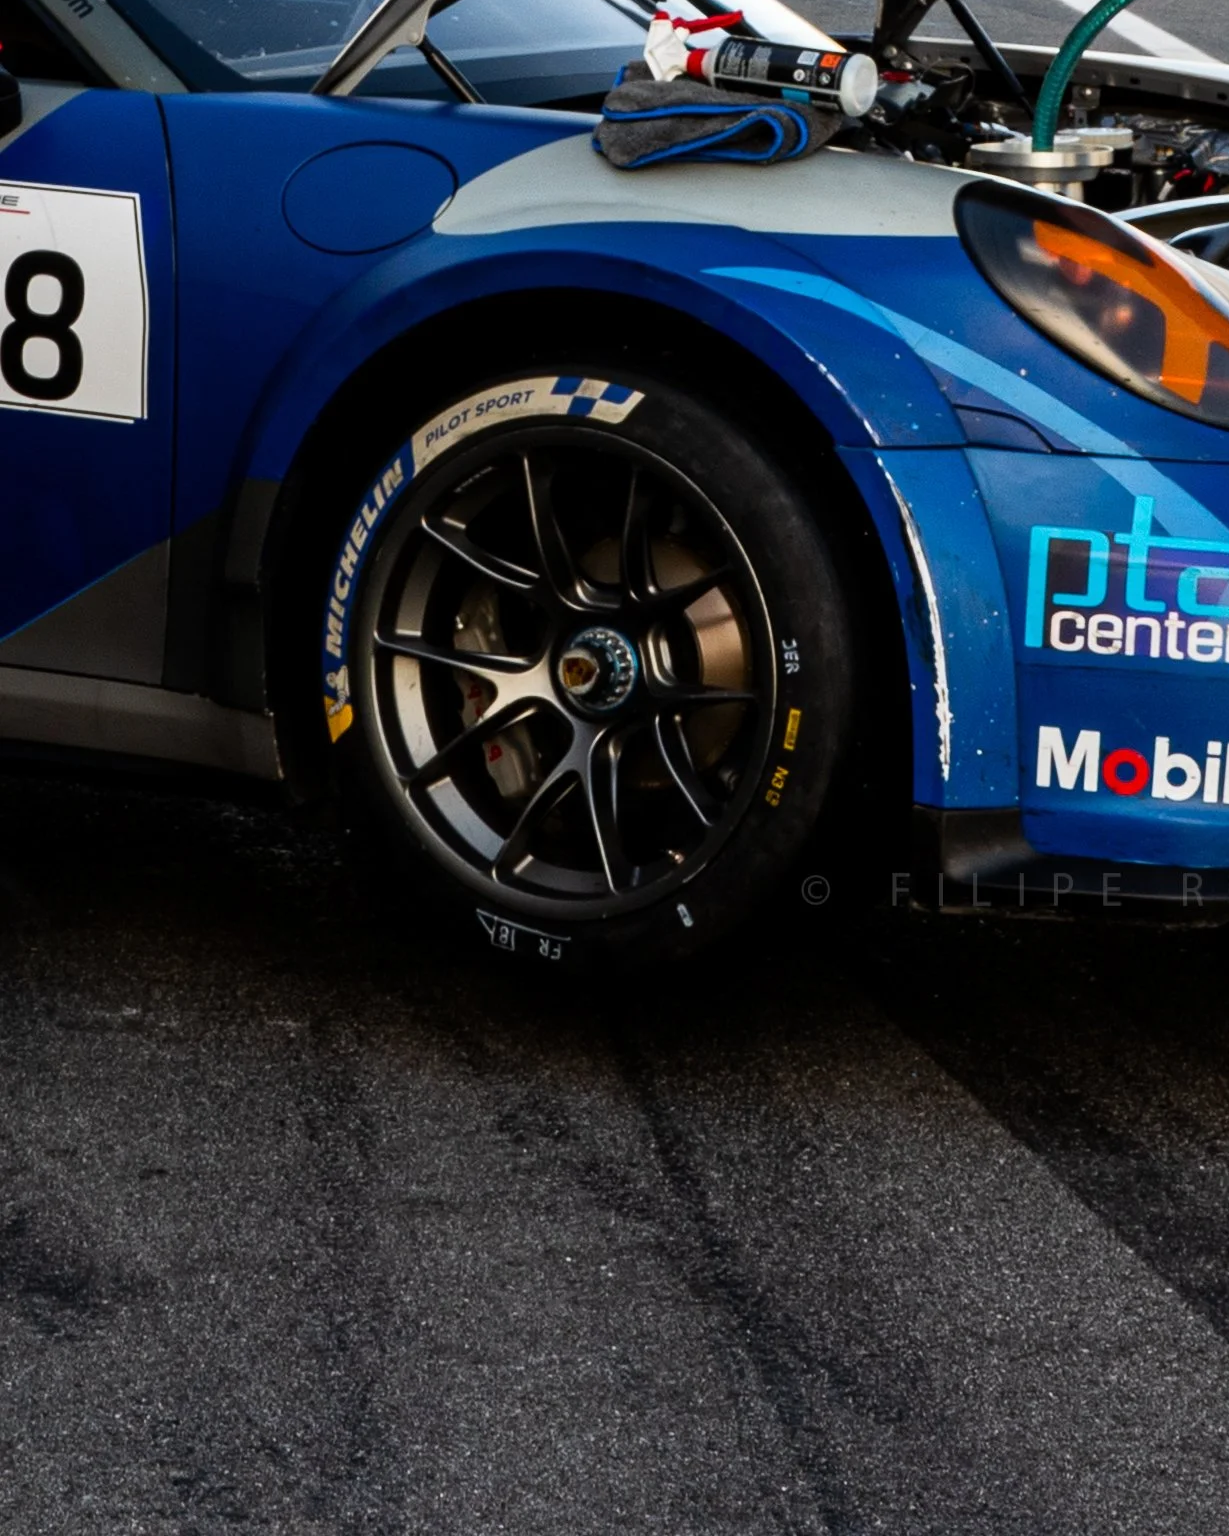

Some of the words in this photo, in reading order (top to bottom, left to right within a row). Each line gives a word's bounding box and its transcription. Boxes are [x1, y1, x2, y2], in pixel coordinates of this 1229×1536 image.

[425, 408, 471, 448] PILOT
[475, 390, 535, 417] SPORT
[326, 457, 404, 659] MICHELIN
